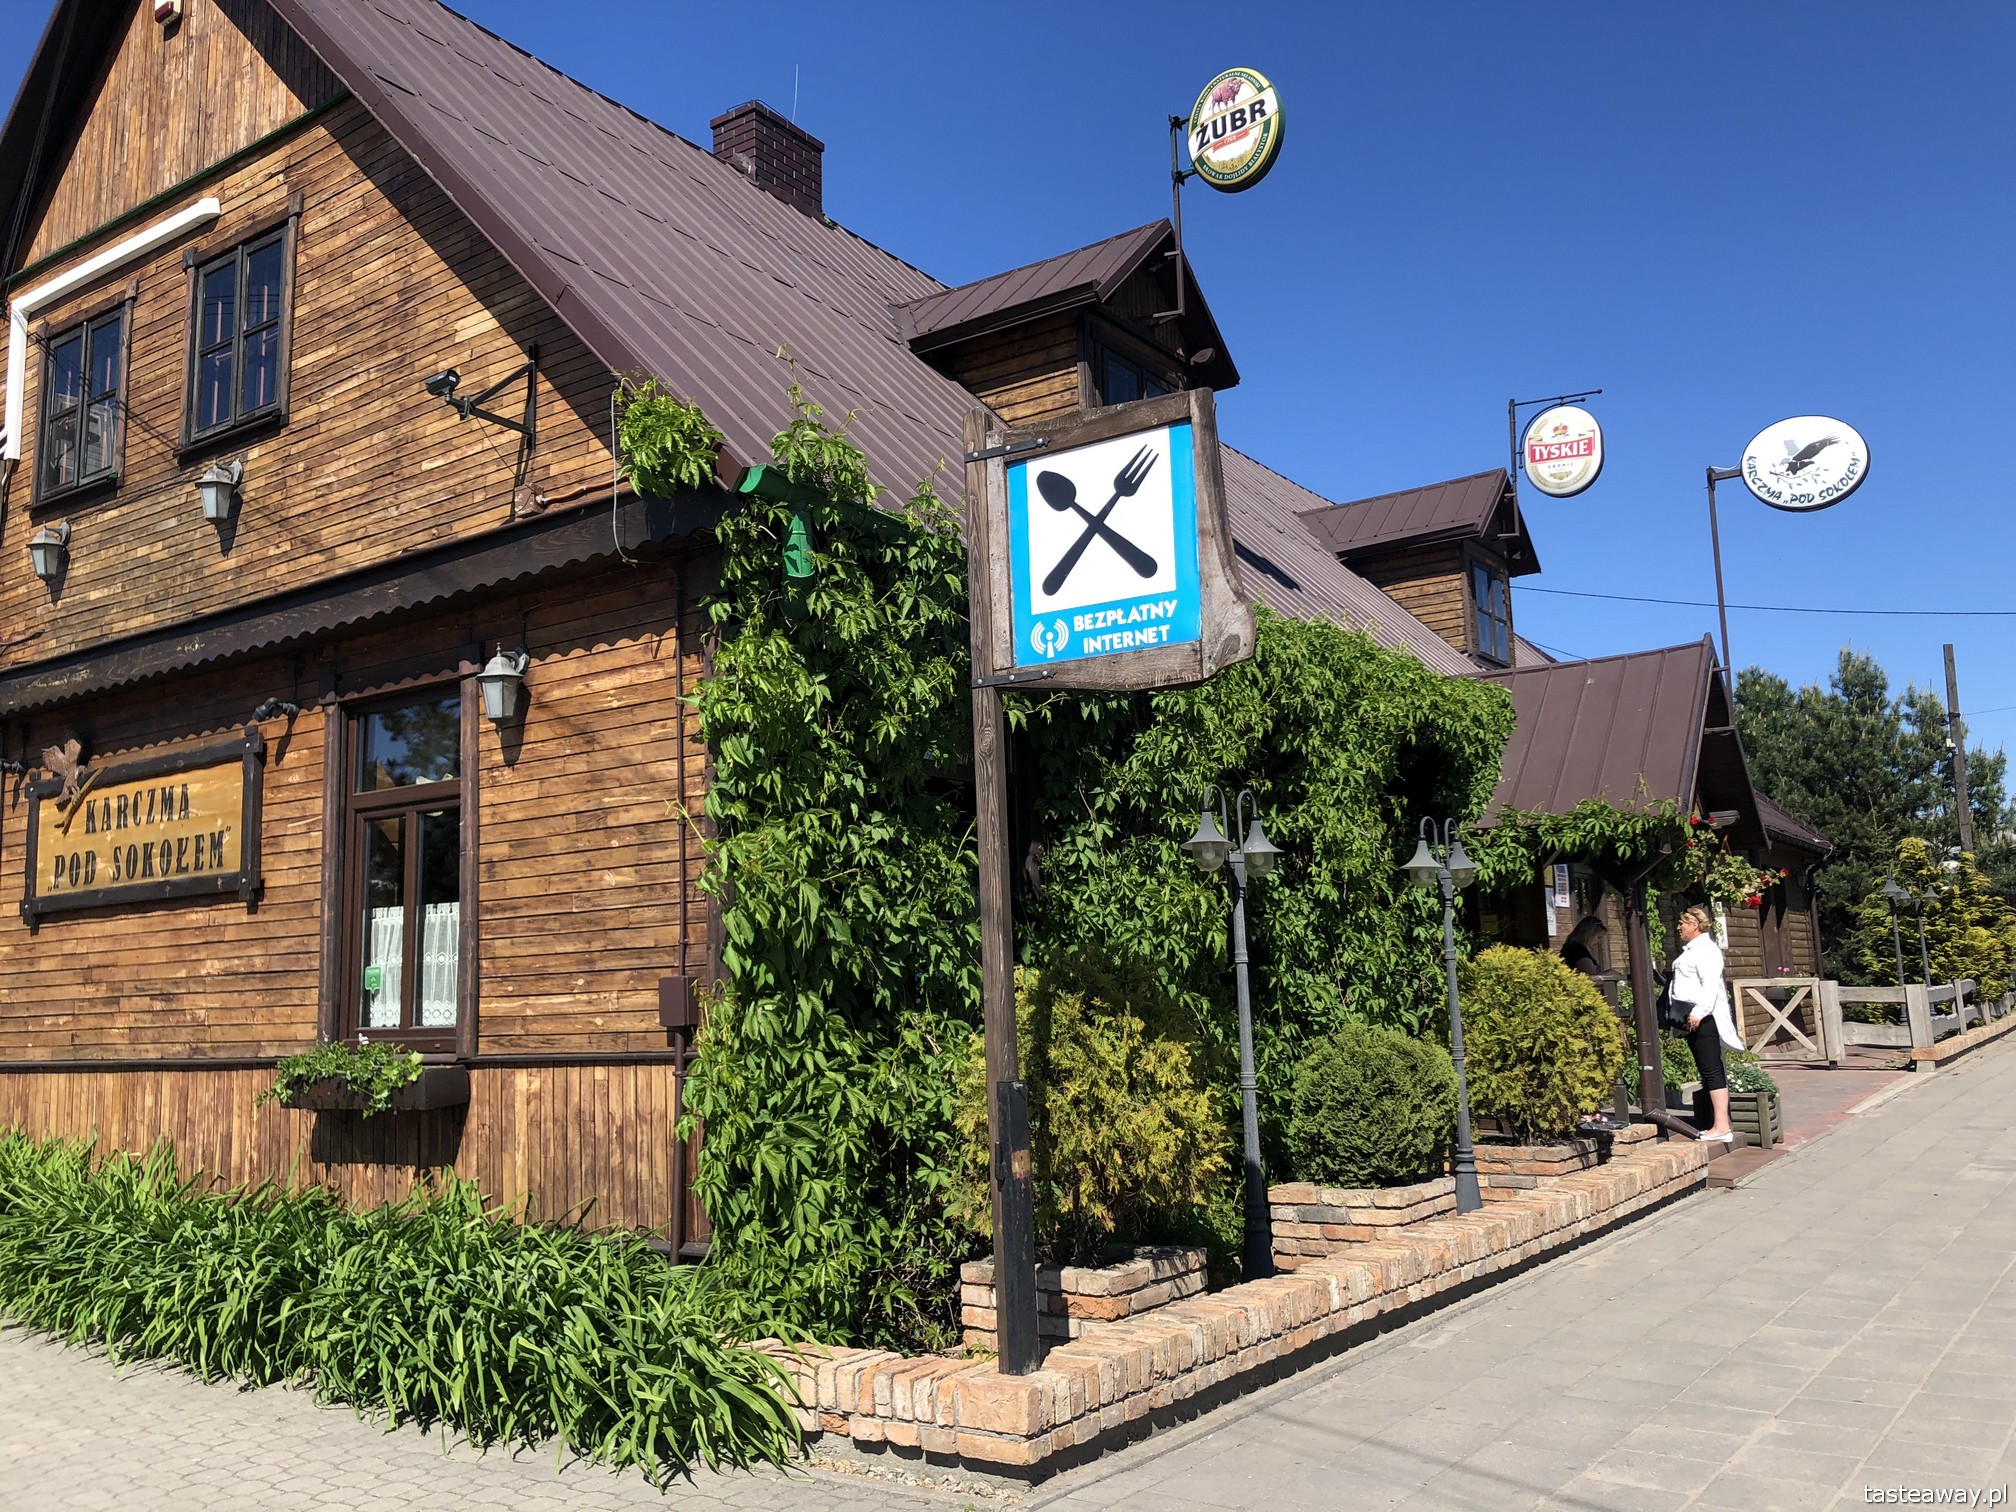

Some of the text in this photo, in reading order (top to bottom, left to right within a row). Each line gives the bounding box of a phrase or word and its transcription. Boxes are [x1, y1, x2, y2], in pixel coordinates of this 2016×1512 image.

[1196, 98, 1267, 153] ŻUBR
[1203, 164, 1223, 179] BROWAR
[1223, 166, 1249, 179] DOJLIDY
[1532, 440, 1589, 461] TYSKIE
[1746, 455, 1782, 502] KARCZMA
[1073, 599, 1178, 632] BEZPŁATNY
[1083, 624, 1170, 654] INTERNET
[84, 783, 191, 835] KARCZMA
